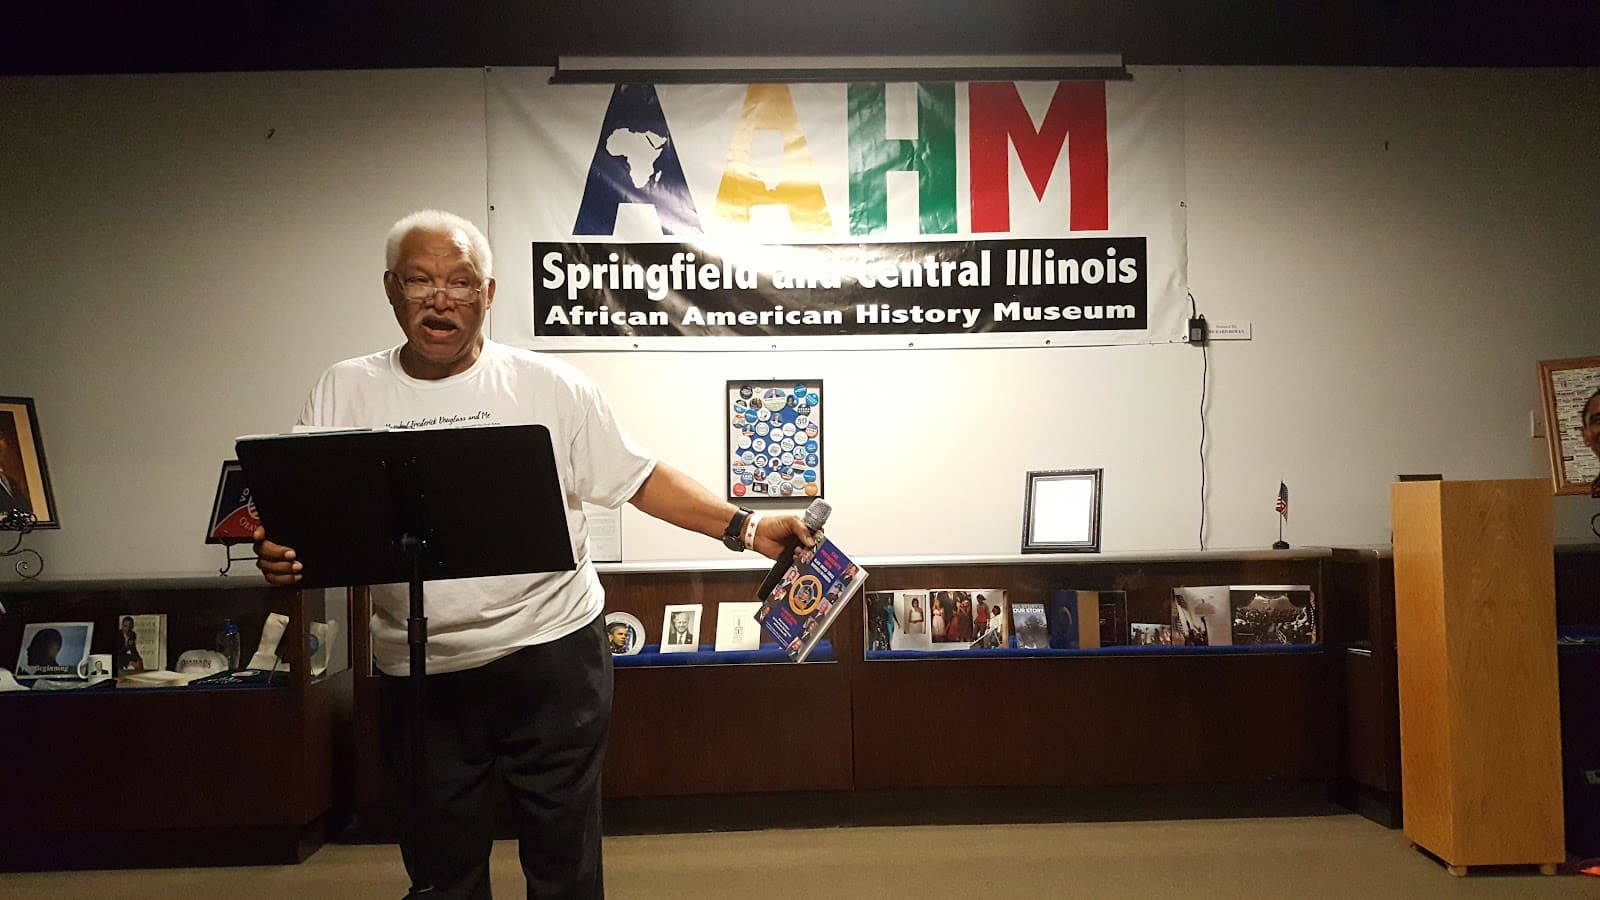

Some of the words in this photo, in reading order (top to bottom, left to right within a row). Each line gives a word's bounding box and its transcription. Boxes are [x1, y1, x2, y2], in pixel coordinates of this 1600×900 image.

[572, 81, 1109, 236] AAHM
[542, 252, 758, 301] Springfield
[771, 257, 842, 290] and
[855, 250, 991, 288] Central
[1006, 247, 1138, 285] Illinois
[545, 305, 669, 326] African
[682, 305, 843, 326] American
[856, 304, 981, 329] History
[993, 303, 1136, 322] Museum
[410, 417, 437, 429] Frederick
[439, 414, 466, 426] Douglass
[468, 411, 482, 421] and
